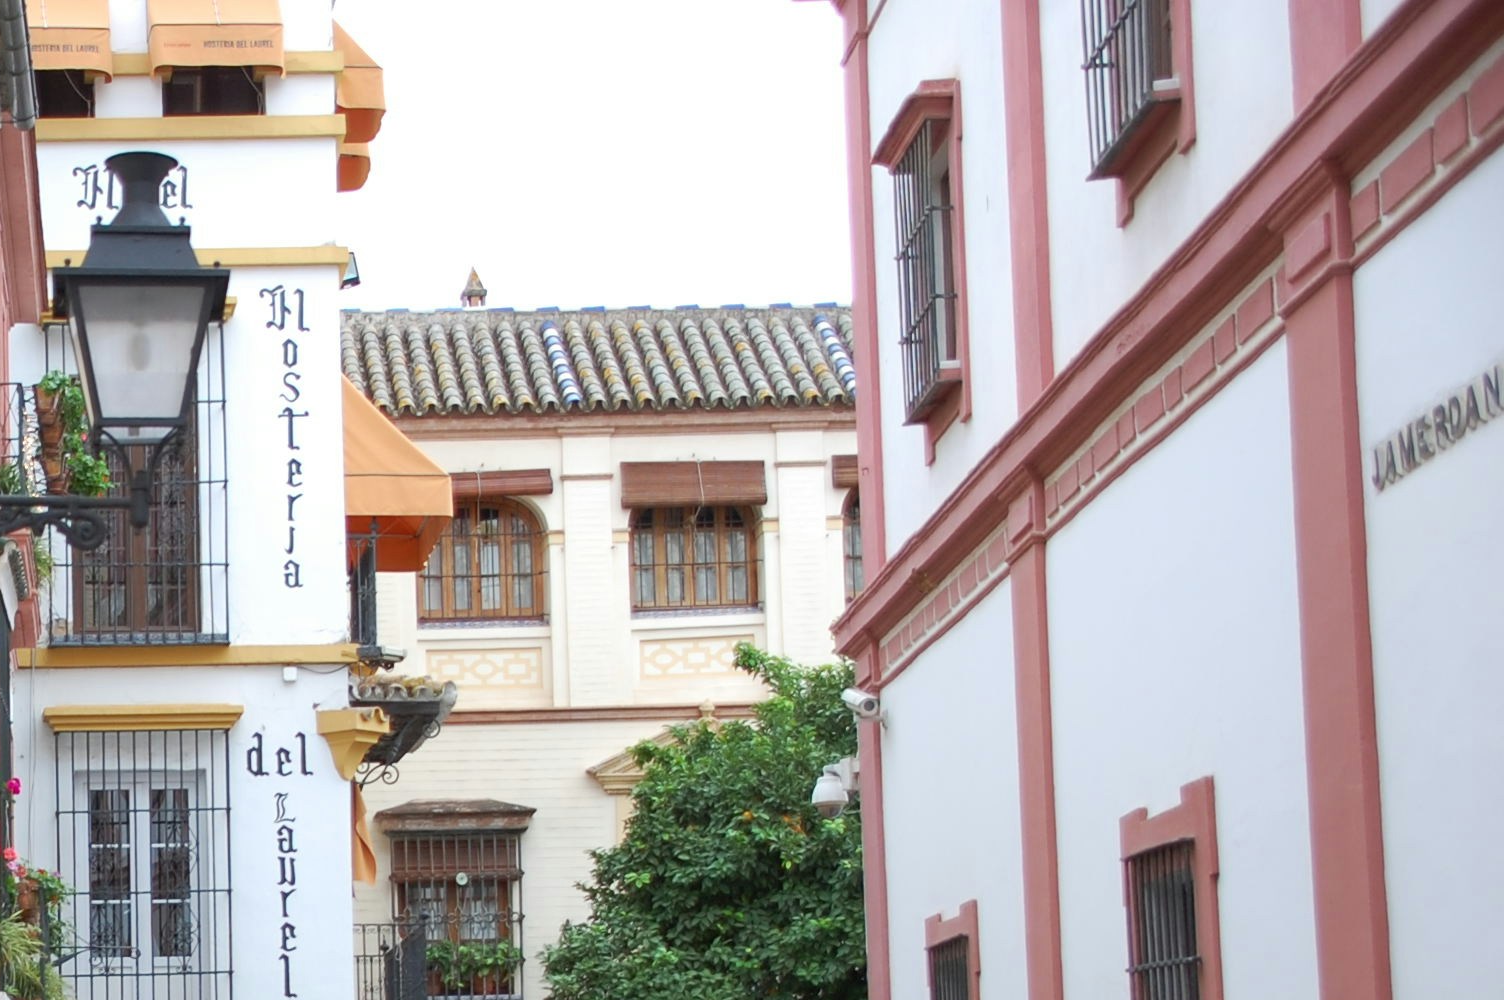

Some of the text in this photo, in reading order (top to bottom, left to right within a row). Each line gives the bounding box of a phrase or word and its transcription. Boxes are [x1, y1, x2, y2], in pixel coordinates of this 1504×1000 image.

[259, 285, 310, 588] Hosteria
[246, 731, 314, 777] del
[273, 792, 297, 998] Laurel
